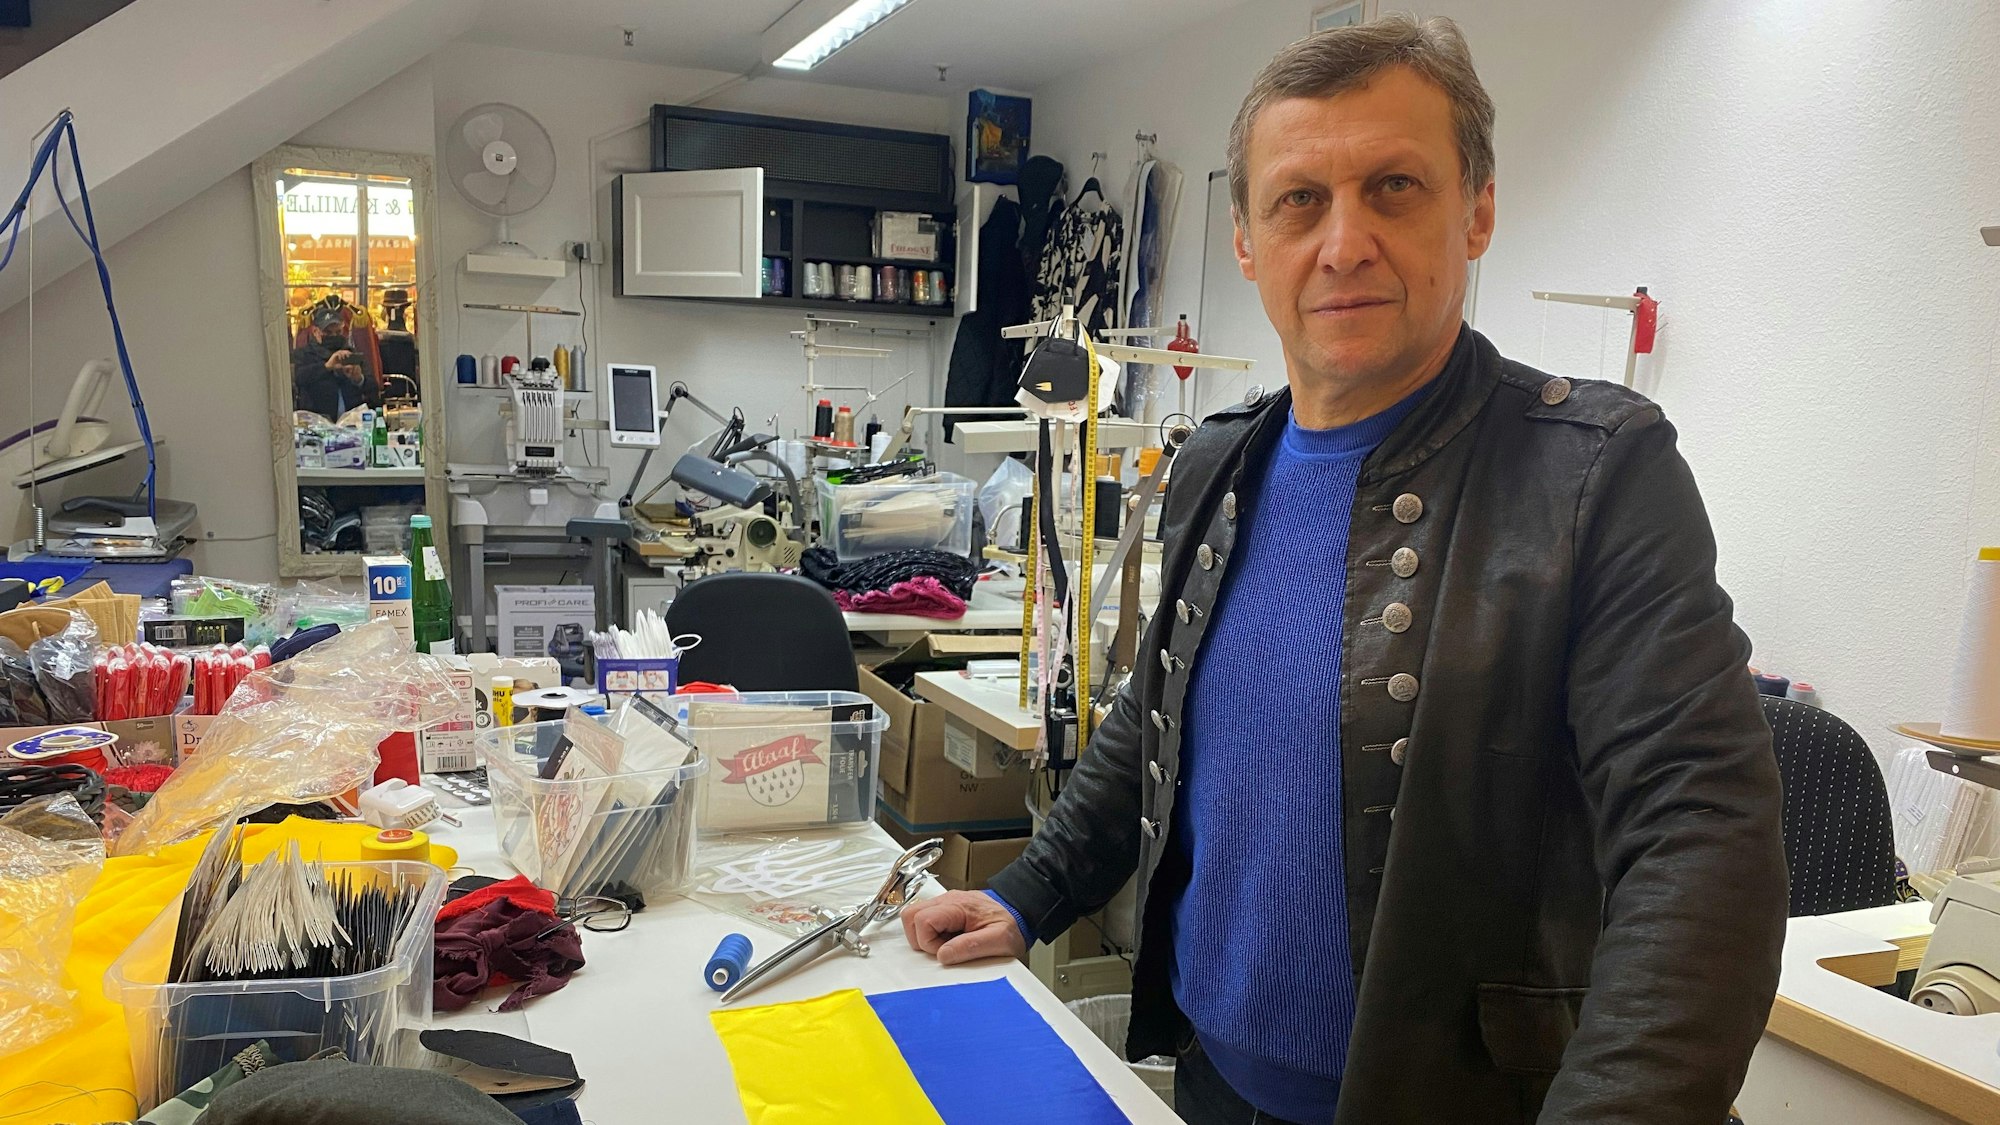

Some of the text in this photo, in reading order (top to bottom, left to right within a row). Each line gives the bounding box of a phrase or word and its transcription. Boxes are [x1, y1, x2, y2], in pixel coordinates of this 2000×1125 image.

[373, 576, 397, 595] 10
[375, 607, 408, 617] FAMEX
[847, 749, 855, 781] TRANSFER
